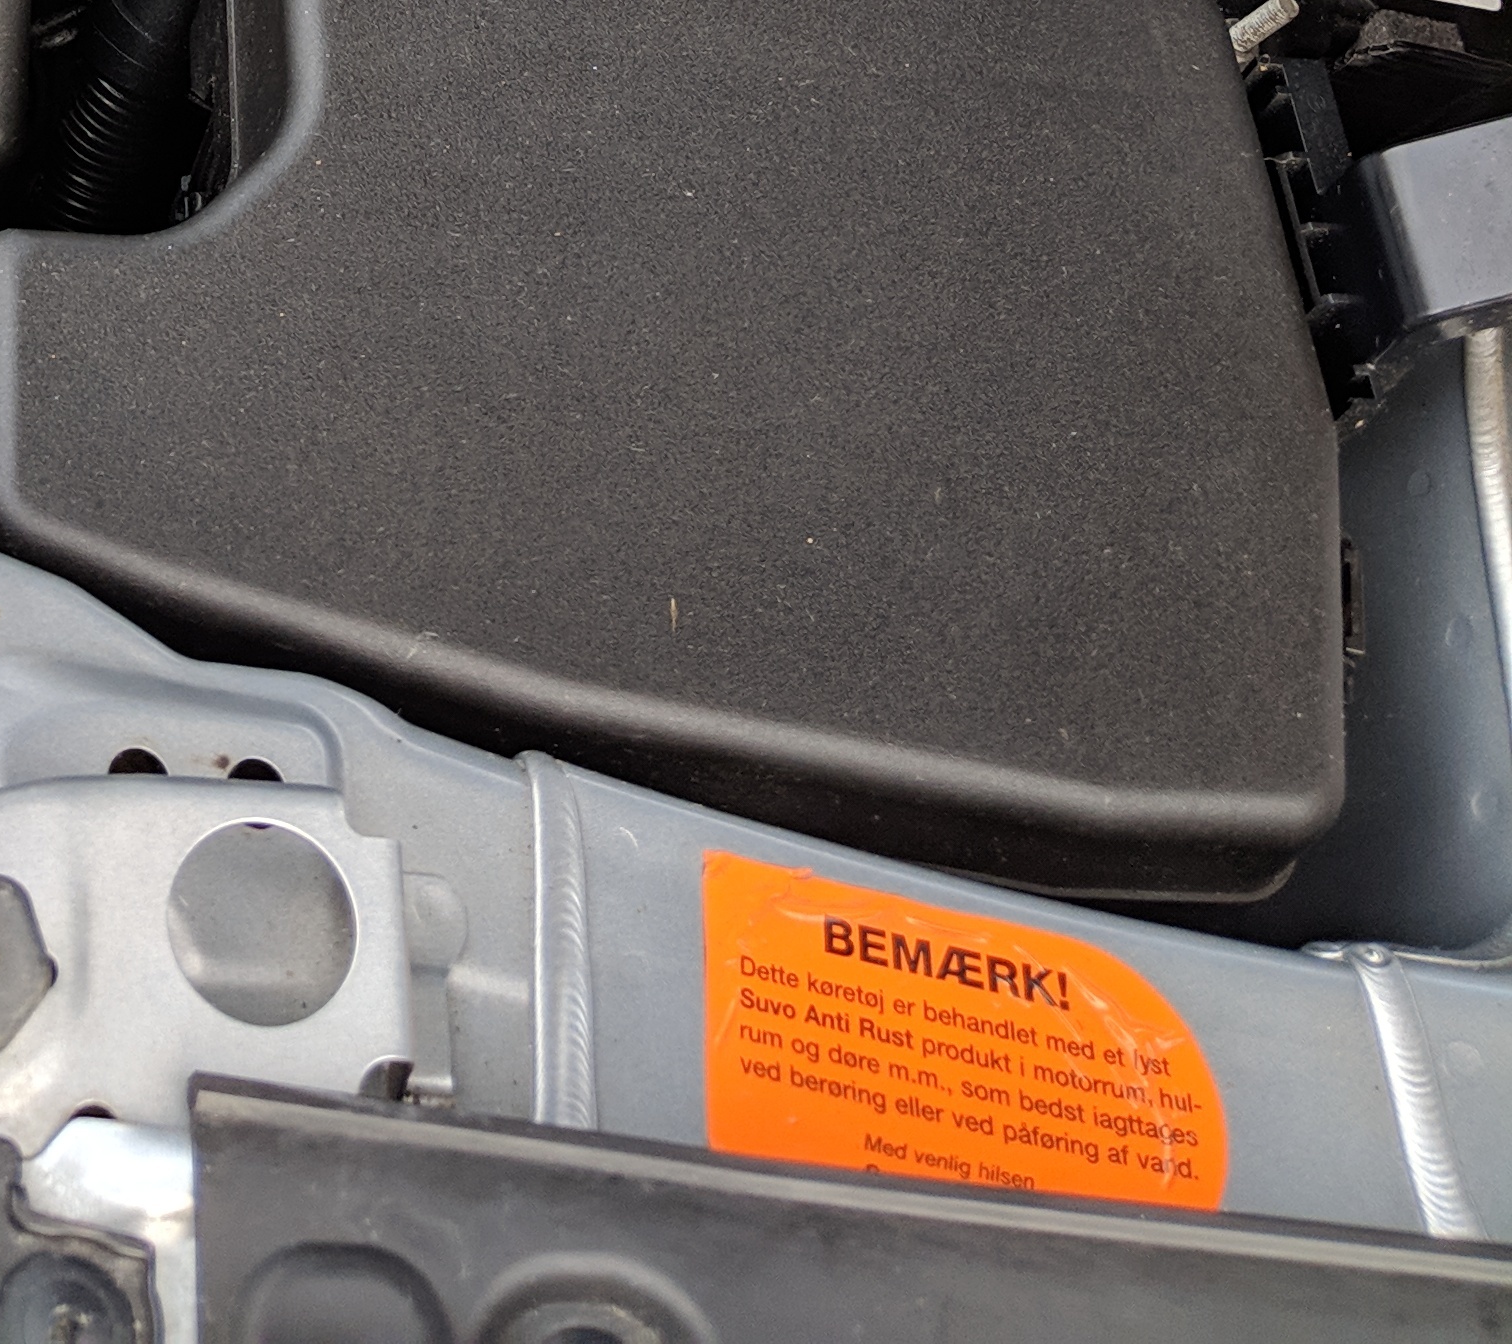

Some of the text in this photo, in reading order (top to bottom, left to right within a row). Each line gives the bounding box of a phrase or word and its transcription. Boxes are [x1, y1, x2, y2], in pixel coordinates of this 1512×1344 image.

[740, 955, 1170, 1080] Dette køretøj er behandlet med et lyst
[824, 914, 1070, 1011] BEMÆRK!
[740, 987, 796, 1020] Suvo
[804, 1004, 850, 1034] Anti
[859, 1019, 914, 1049] Rust
[921, 1037, 1012, 1074] produkt
[1033, 1065, 1154, 1108] motorrum,
[1159, 1087, 1202, 1115] hul-
[740, 1023, 1199, 1147] rum og døre m.m., som bedst iagttages
[740, 1056, 1200, 1182] ved berøring eller ved påføring af vand.
[864, 1133, 1035, 1190] Med venlig hilsen
